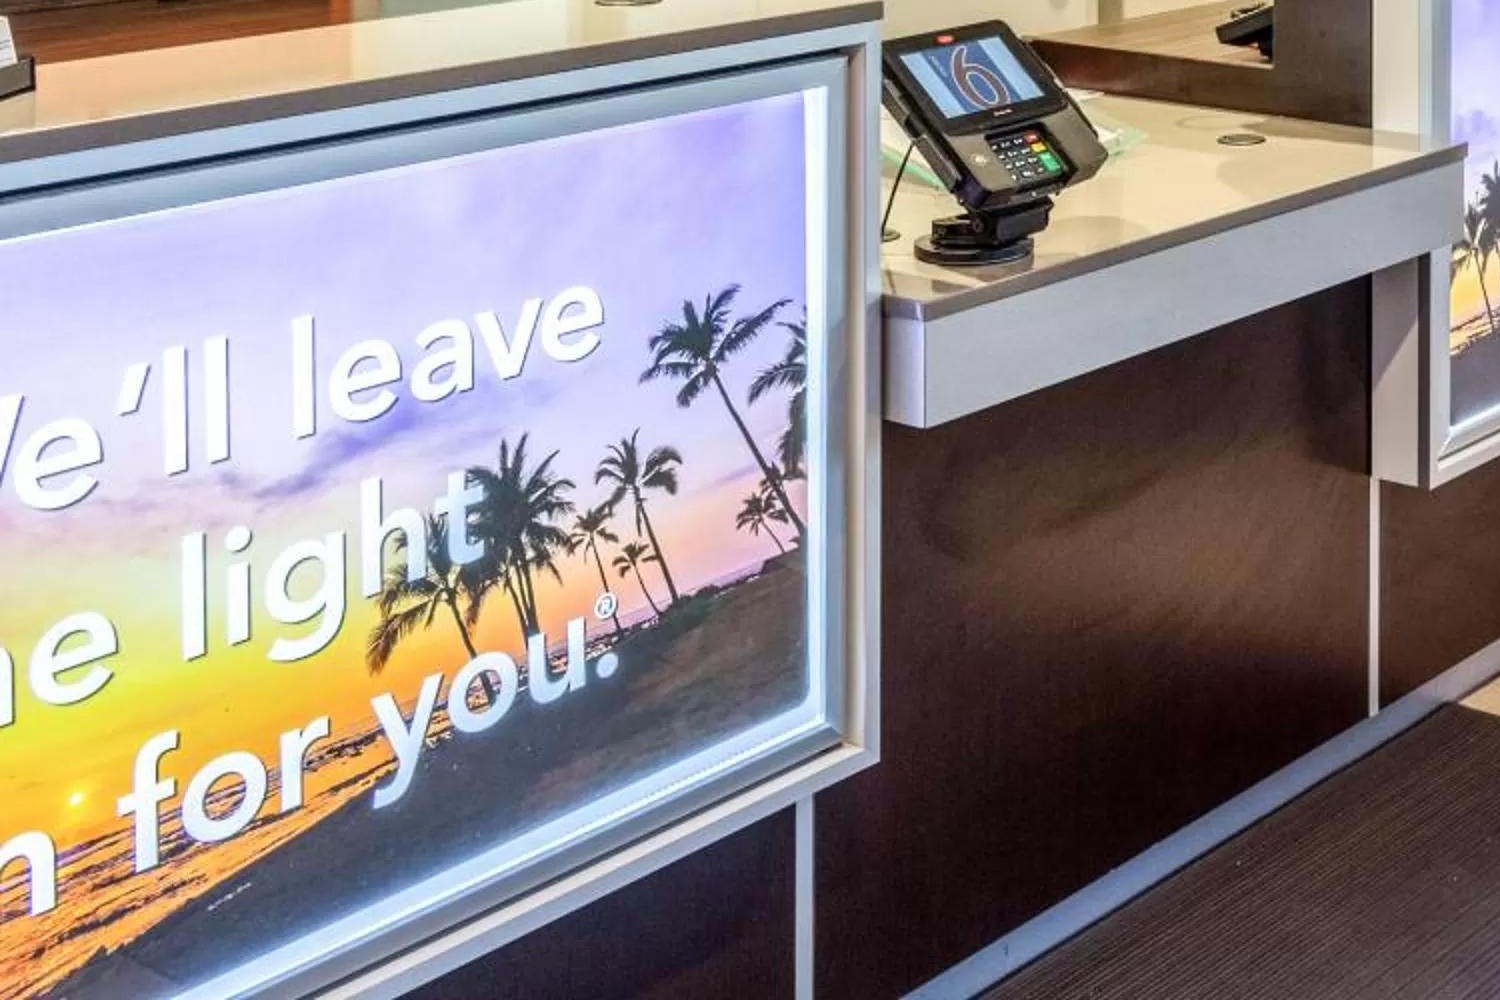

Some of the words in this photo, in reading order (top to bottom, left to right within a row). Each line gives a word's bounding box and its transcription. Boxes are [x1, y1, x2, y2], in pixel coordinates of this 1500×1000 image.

[0, 336, 230, 511] e'll
[291, 284, 605, 440] leave
[181, 466, 488, 665] light
[117, 712, 331, 876] for
